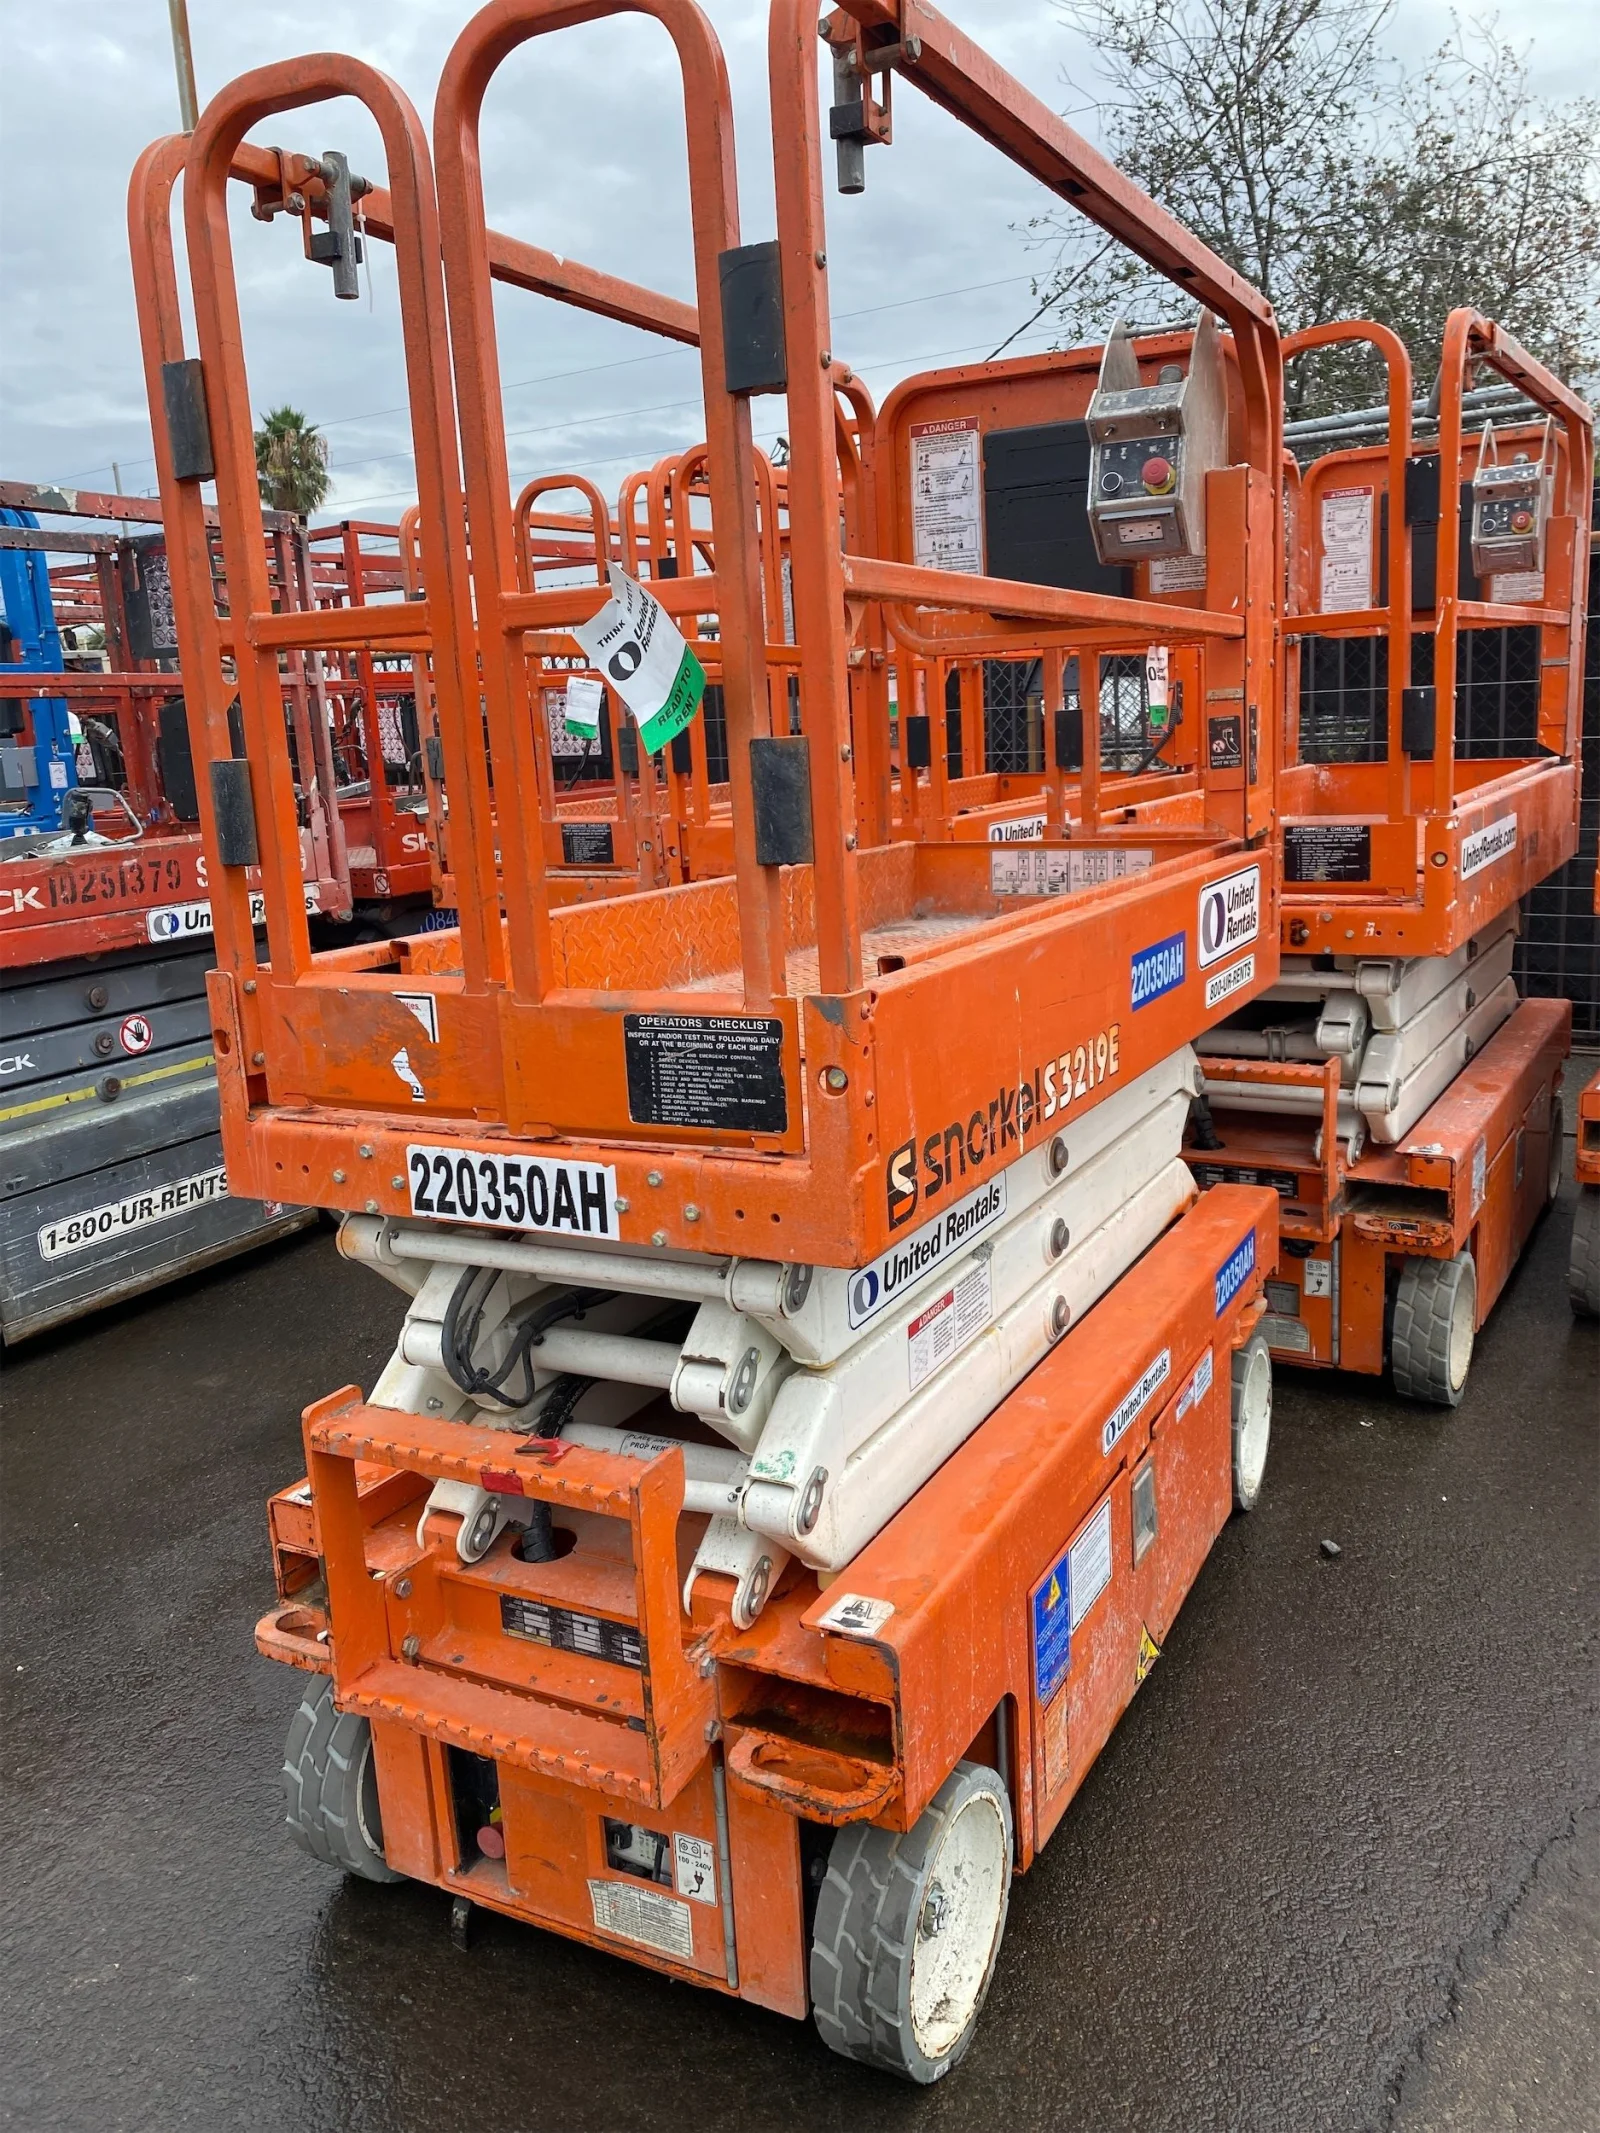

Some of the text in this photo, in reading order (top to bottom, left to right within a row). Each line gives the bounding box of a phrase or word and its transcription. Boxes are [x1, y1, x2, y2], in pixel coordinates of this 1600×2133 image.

[929, 421, 967, 433] DANGER
[1336, 489, 1365, 498] DANGER
[634, 590, 649, 640] United
[641, 601, 659, 652] Rentals
[597, 621, 626, 648] THINK
[657, 667, 692, 726] READY TO
[674, 695, 695, 727] RENT
[1005, 822, 1035, 841] United
[50, 859, 181, 908] 10251379
[1227, 877, 1256, 914] United
[1226, 910, 1257, 943] Rentals
[1131, 941, 1184, 1004] 220350AH
[1209, 960, 1252, 1001] 800-UR-RENTS
[627, 1031, 655, 1039] INSPECT
[718, 1035, 758, 1043] FOLLOWING
[639, 1016, 770, 1030] OPERATORS CHECKLIST
[923, 1067, 1041, 1199] snorkel
[1043, 1022, 1121, 1121] S3219E
[46, 1171, 228, 1251] 1-800-UR-RENTS
[411, 1152, 608, 1233] 220350AH
[883, 1184, 1000, 1293] United Rentals
[1215, 1236, 1254, 1314] 220350AH
[922, 1299, 946, 1325] DANGER
[1117, 1358, 1168, 1432] United Rentals
[629, 1434, 683, 1446] PLACE SAFETY
[630, 1441, 650, 1450] PROP
[678, 1855, 690, 1865] 100
[695, 1861, 712, 1872] 240V
